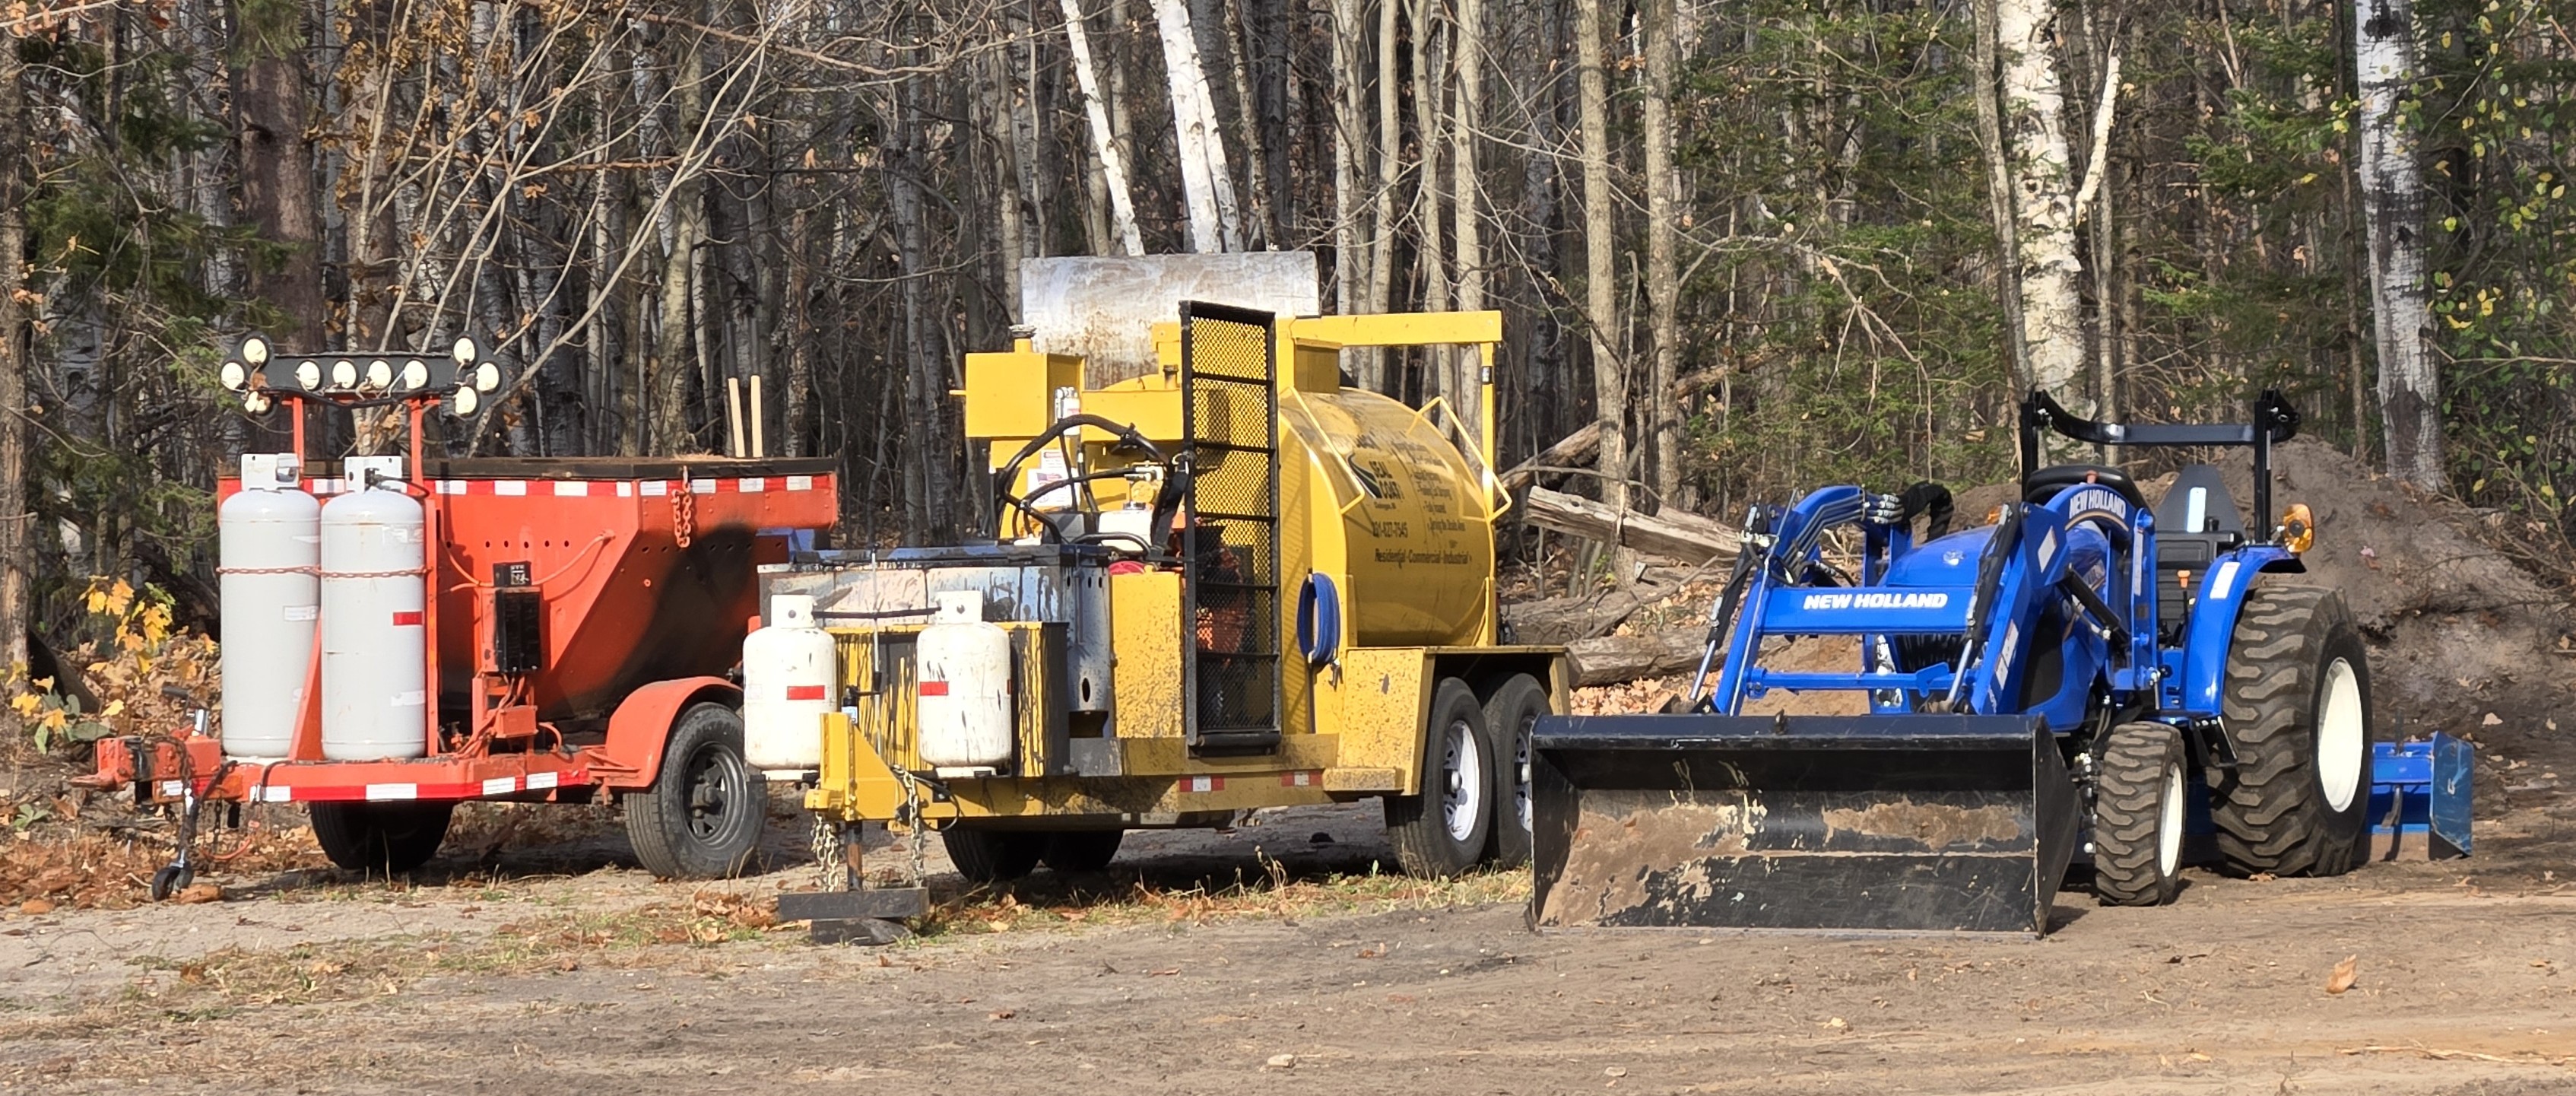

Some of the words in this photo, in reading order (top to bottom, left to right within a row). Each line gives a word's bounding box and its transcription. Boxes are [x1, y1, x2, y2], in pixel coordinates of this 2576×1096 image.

[1369, 460, 1393, 478] SEAL
[2069, 489, 2089, 519] NEW
[2088, 489, 2126, 519] HOLLAND
[1803, 594, 1853, 609] NEW
[1853, 593, 1948, 608] HOLLAND
